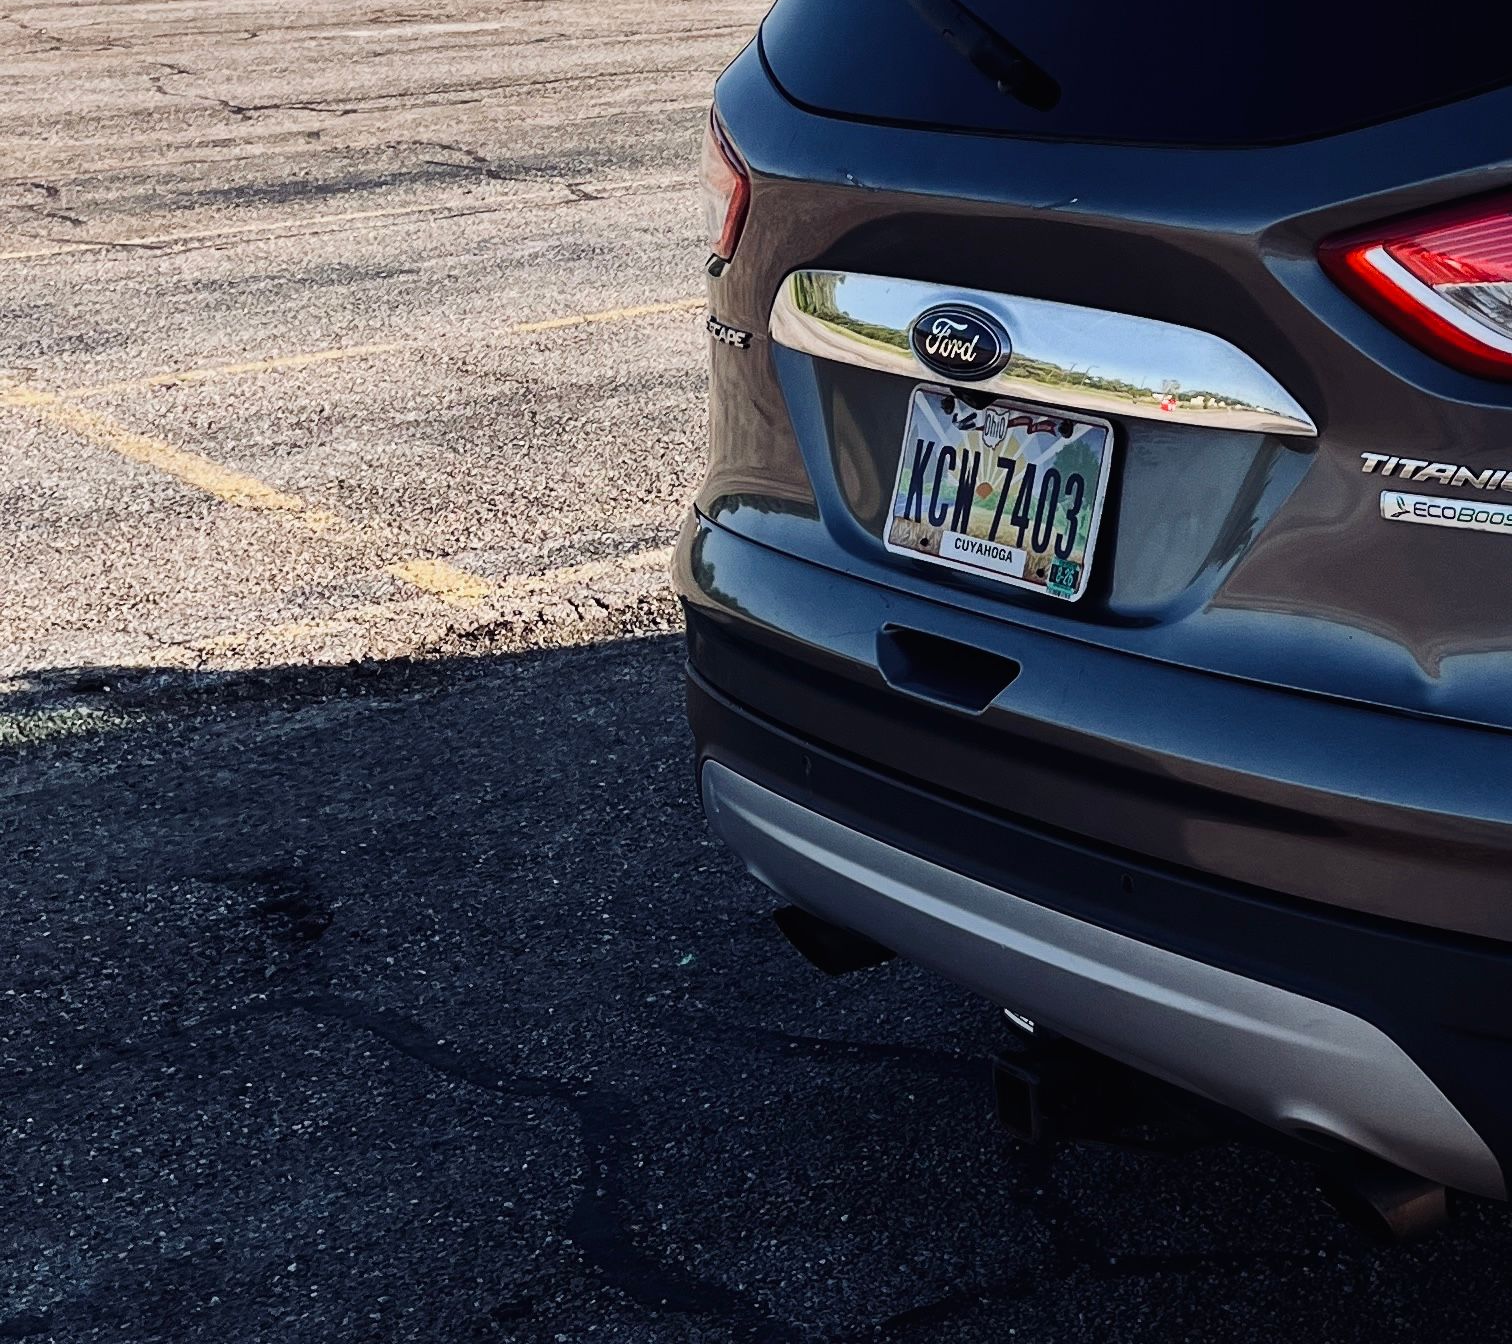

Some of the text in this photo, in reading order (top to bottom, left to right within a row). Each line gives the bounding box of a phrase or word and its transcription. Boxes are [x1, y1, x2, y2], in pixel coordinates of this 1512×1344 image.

[707, 320, 747, 348] CAPE
[925, 317, 980, 362] Ford
[984, 413, 1006, 439] Ohio
[904, 439, 1084, 560] KCW 7403
[954, 537, 1013, 564] CUYAHOGA
